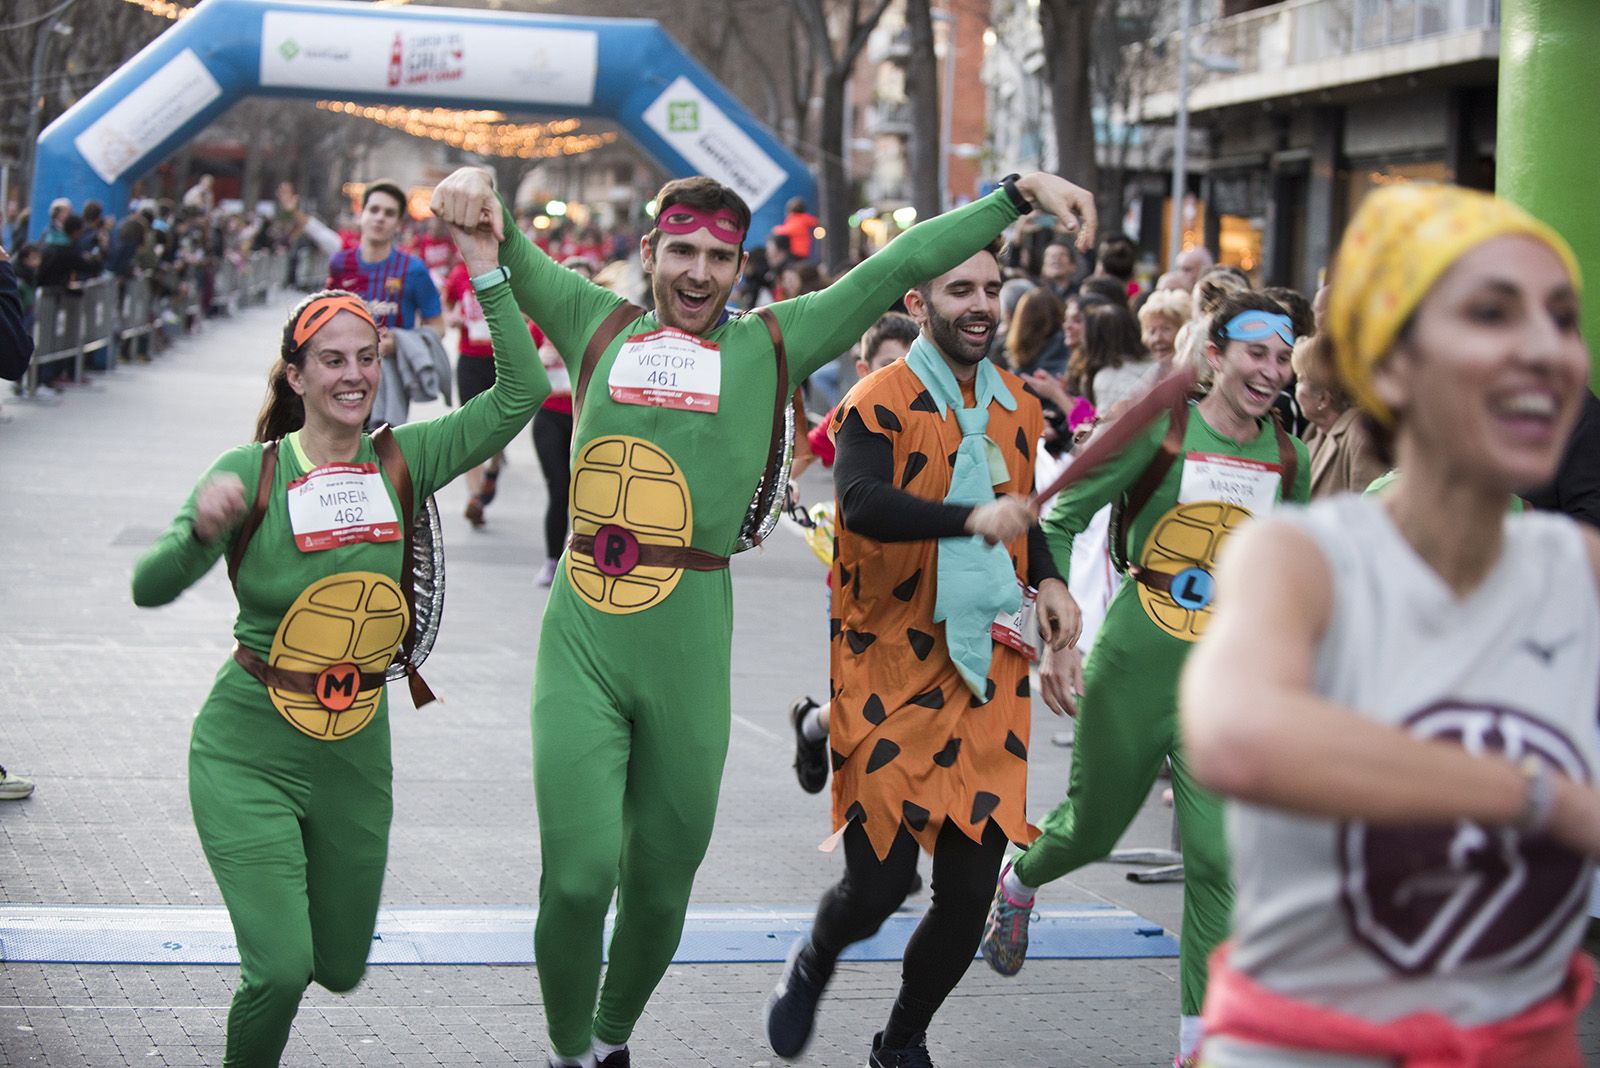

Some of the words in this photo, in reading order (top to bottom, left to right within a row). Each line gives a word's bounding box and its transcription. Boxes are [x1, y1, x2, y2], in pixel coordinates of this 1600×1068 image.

[638, 354, 696, 370] VICTOR
[647, 370, 678, 387] 461
[319, 490, 370, 507] MIREIA
[334, 507, 365, 524] 462
[604, 534, 627, 568] R
[1181, 574, 1204, 604] L
[323, 672, 355, 699] M
